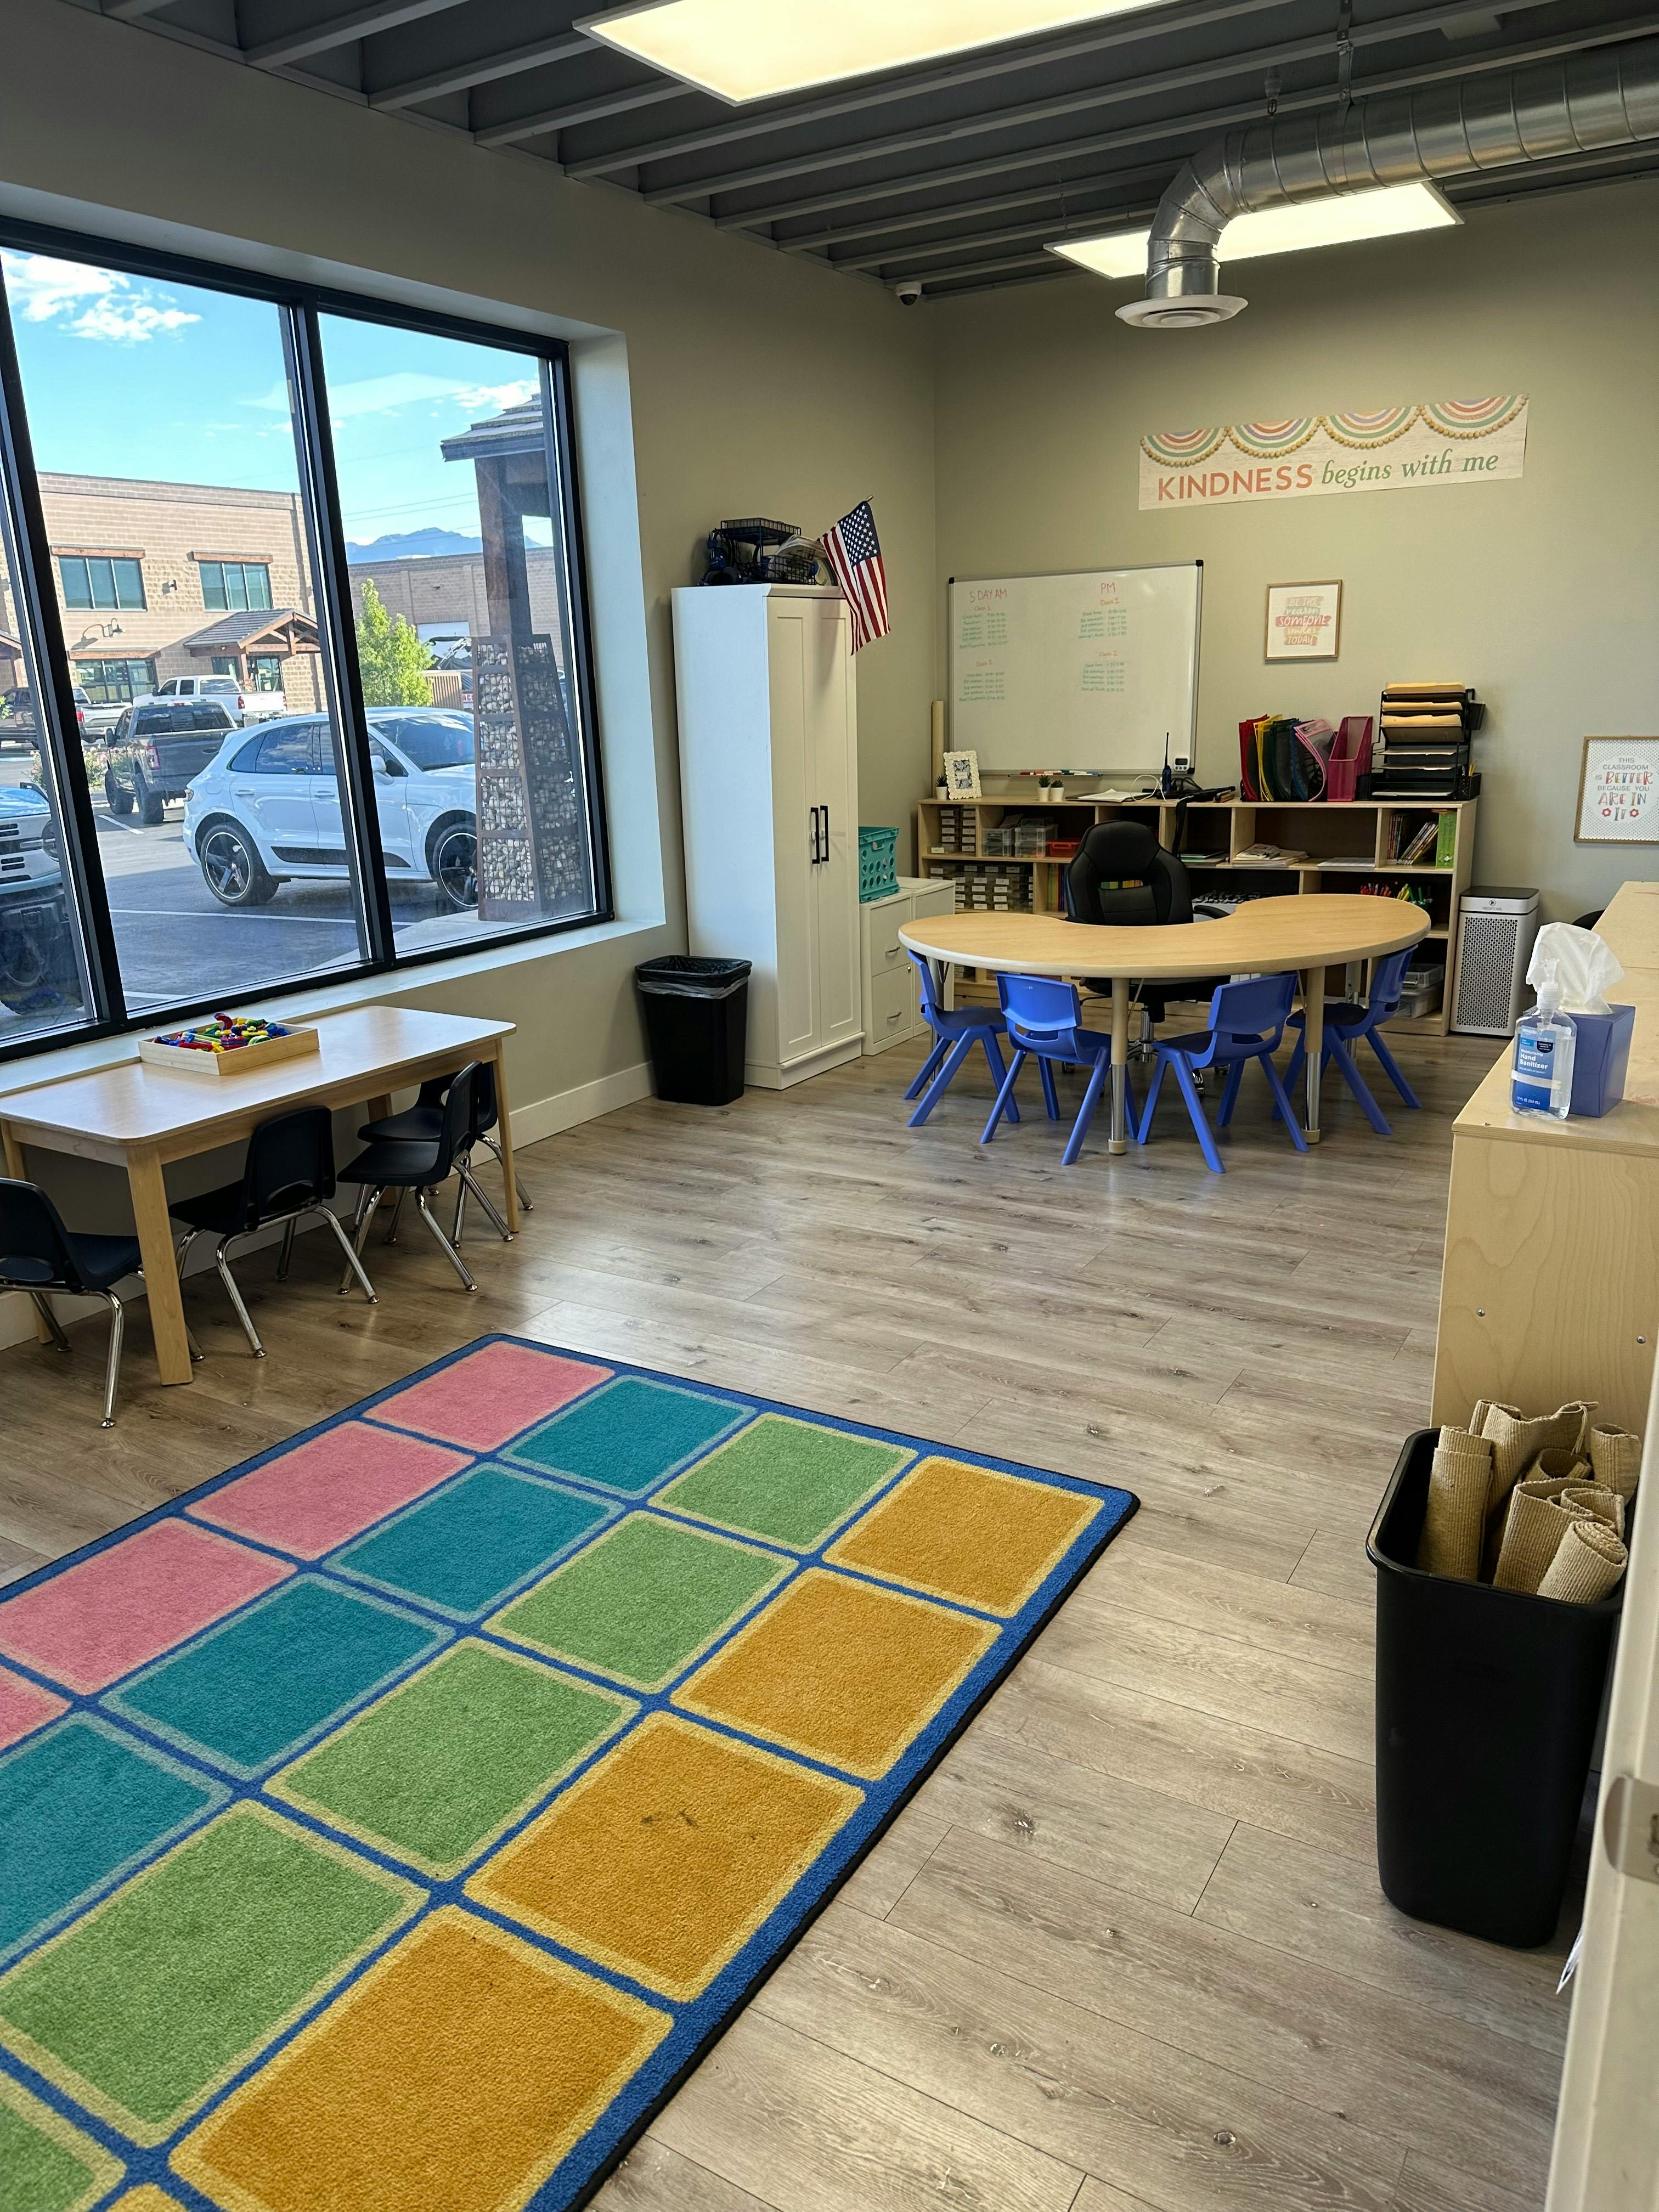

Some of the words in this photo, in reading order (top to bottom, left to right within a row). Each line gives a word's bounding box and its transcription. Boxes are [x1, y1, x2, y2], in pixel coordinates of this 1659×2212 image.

[1158, 464, 1313, 501] KINDNESS
[1322, 459, 1391, 488] begins
[1401, 449, 1453, 478] with
[1462, 455, 1499, 472] me
[978, 590, 992, 600] DAY
[995, 588, 1007, 599] AM
[1101, 582, 1116, 594] PM
[1290, 597, 1300, 607] BE
[1303, 596, 1317, 606] THE
[1286, 607, 1319, 616] reason
[1278, 615, 1327, 627] SOMEONE
[1288, 635, 1314, 646] TODAY
[1605, 771, 1654, 786] BETTER
[1598, 792, 1627, 806] ARE
[1630, 792, 1646, 806] IN
[1613, 807, 1627, 821] IT
[1520, 1053, 1536, 1062] Hand
[1520, 1059, 1548, 1069] Sanitizer
